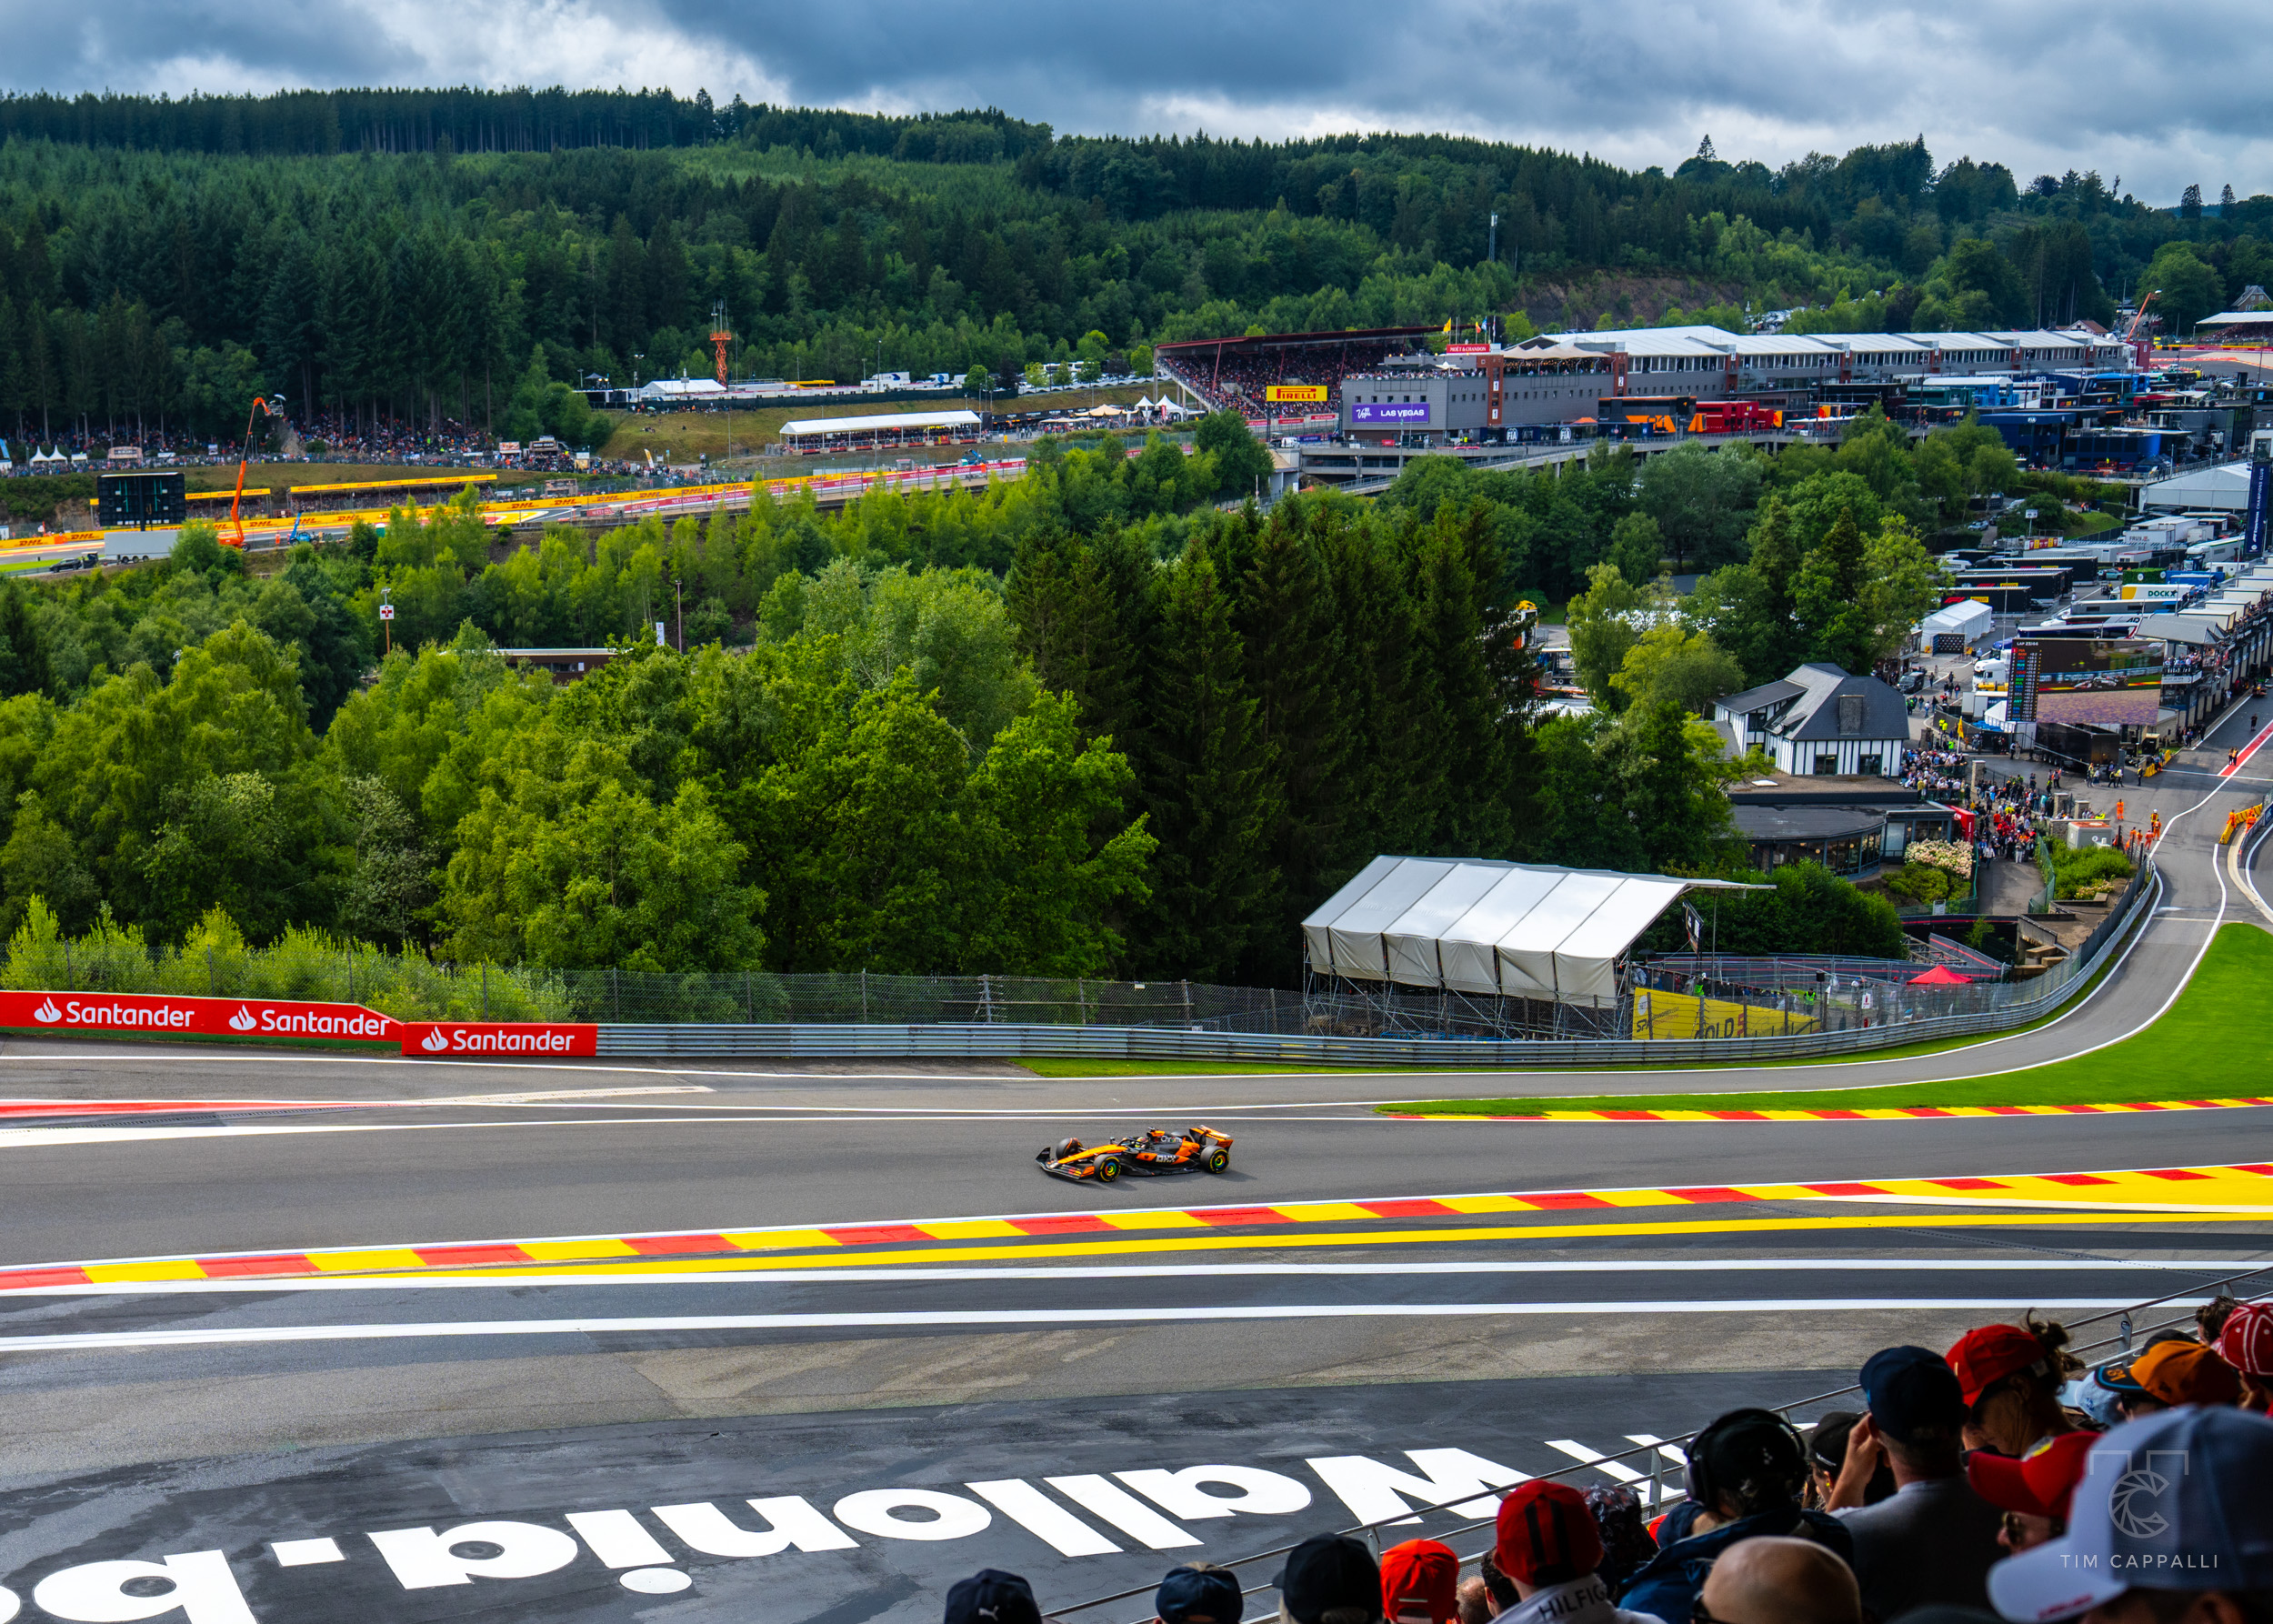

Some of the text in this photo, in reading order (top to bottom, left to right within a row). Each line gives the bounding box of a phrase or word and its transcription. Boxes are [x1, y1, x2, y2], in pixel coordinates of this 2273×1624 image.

[1277, 388, 1317, 399] PIRELLI
[65, 1000, 195, 1028] Santander
[261, 1009, 390, 1036] Santander
[453, 1029, 575, 1051] Santander
[2107, 1368, 2127, 1381] 81
[0, 1446, 1537, 1624] Wallonia.b
